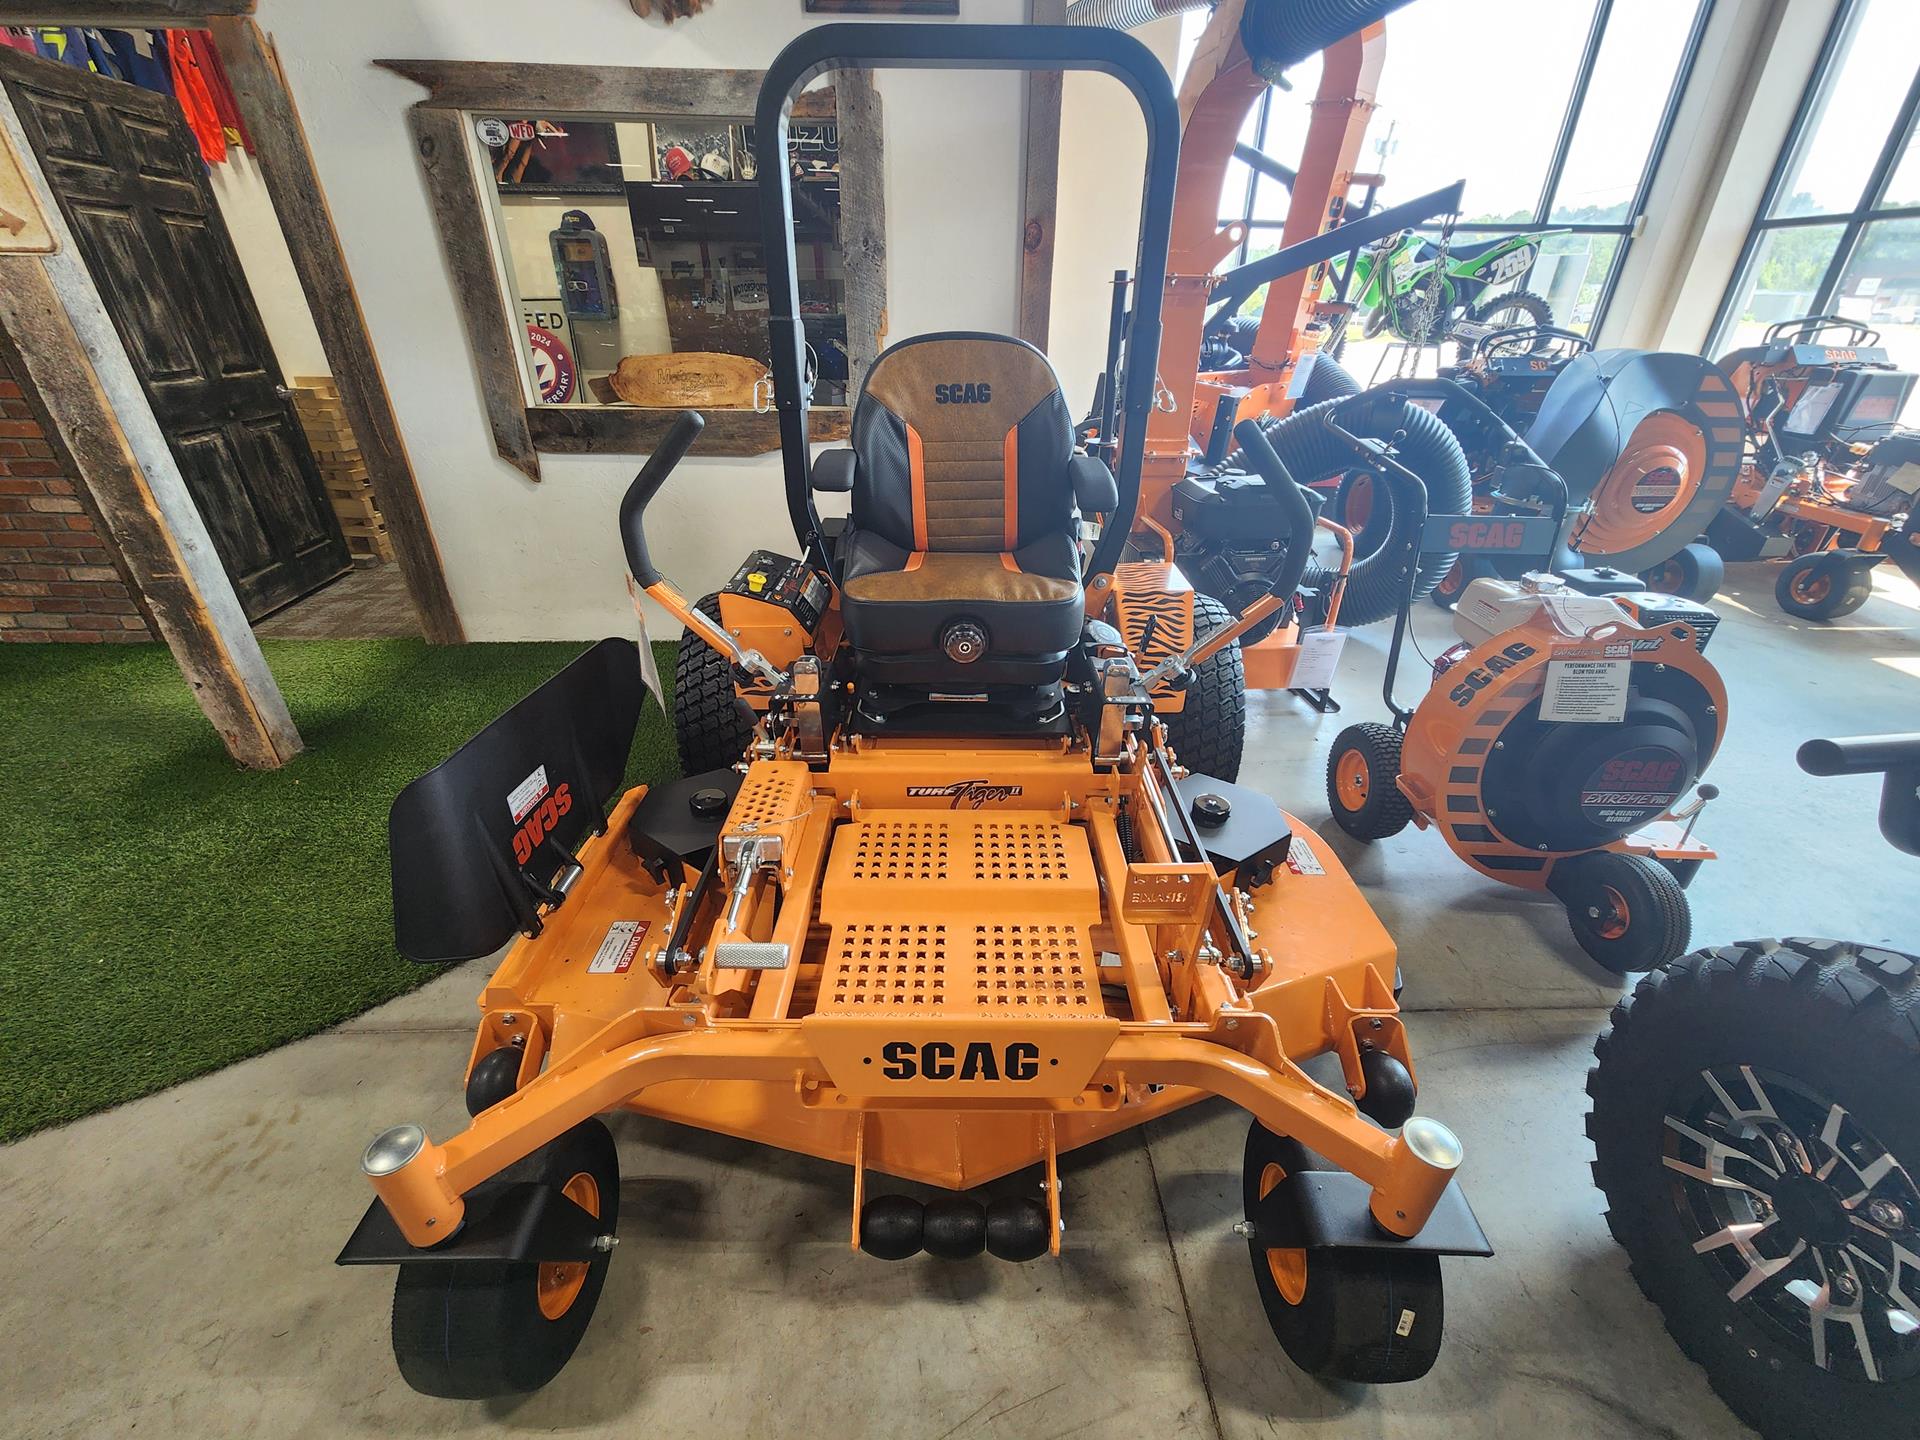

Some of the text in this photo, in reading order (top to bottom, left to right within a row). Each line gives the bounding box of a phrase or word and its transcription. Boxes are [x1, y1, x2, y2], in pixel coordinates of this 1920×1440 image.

[510, 125, 534, 138] WFO
[1492, 246, 1532, 284] 259
[530, 332, 552, 347] 2024
[1824, 349, 1857, 360] SCAG
[935, 382, 992, 405] SCAG
[1449, 522, 1525, 549] SCAG
[1605, 645, 1630, 654] SCAG
[1450, 642, 1536, 707] SCAG
[1603, 760, 1680, 781] SCAG
[908, 787, 957, 796] TURF
[946, 779, 1008, 810] Tiger
[1585, 793, 1670, 805] EXTREME PRO
[512, 783, 573, 865] SCAG
[618, 936, 642, 968] DANGER
[882, 1041, 1040, 1081] SCAG
